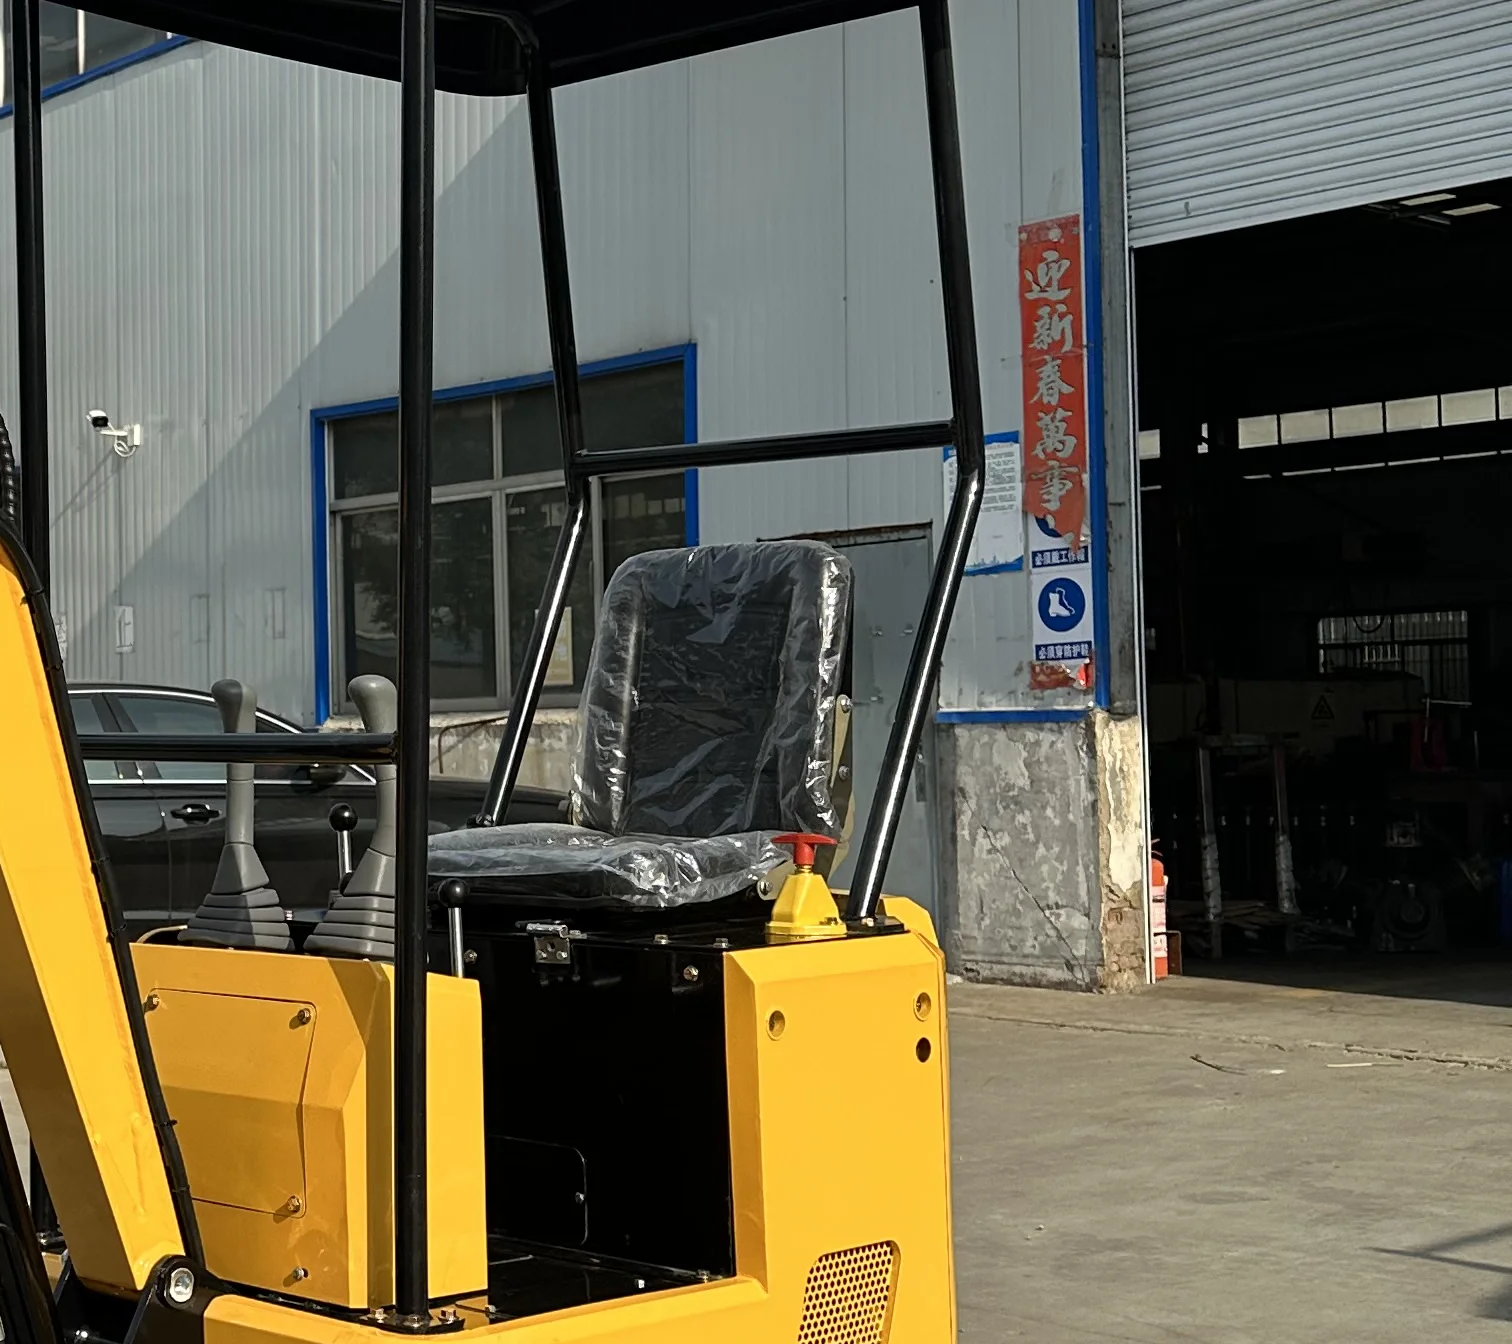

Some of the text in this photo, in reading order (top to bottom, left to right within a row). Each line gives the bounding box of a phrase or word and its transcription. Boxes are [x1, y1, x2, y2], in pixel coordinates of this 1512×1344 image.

[1024, 250, 1079, 542] 迎新春萬事
